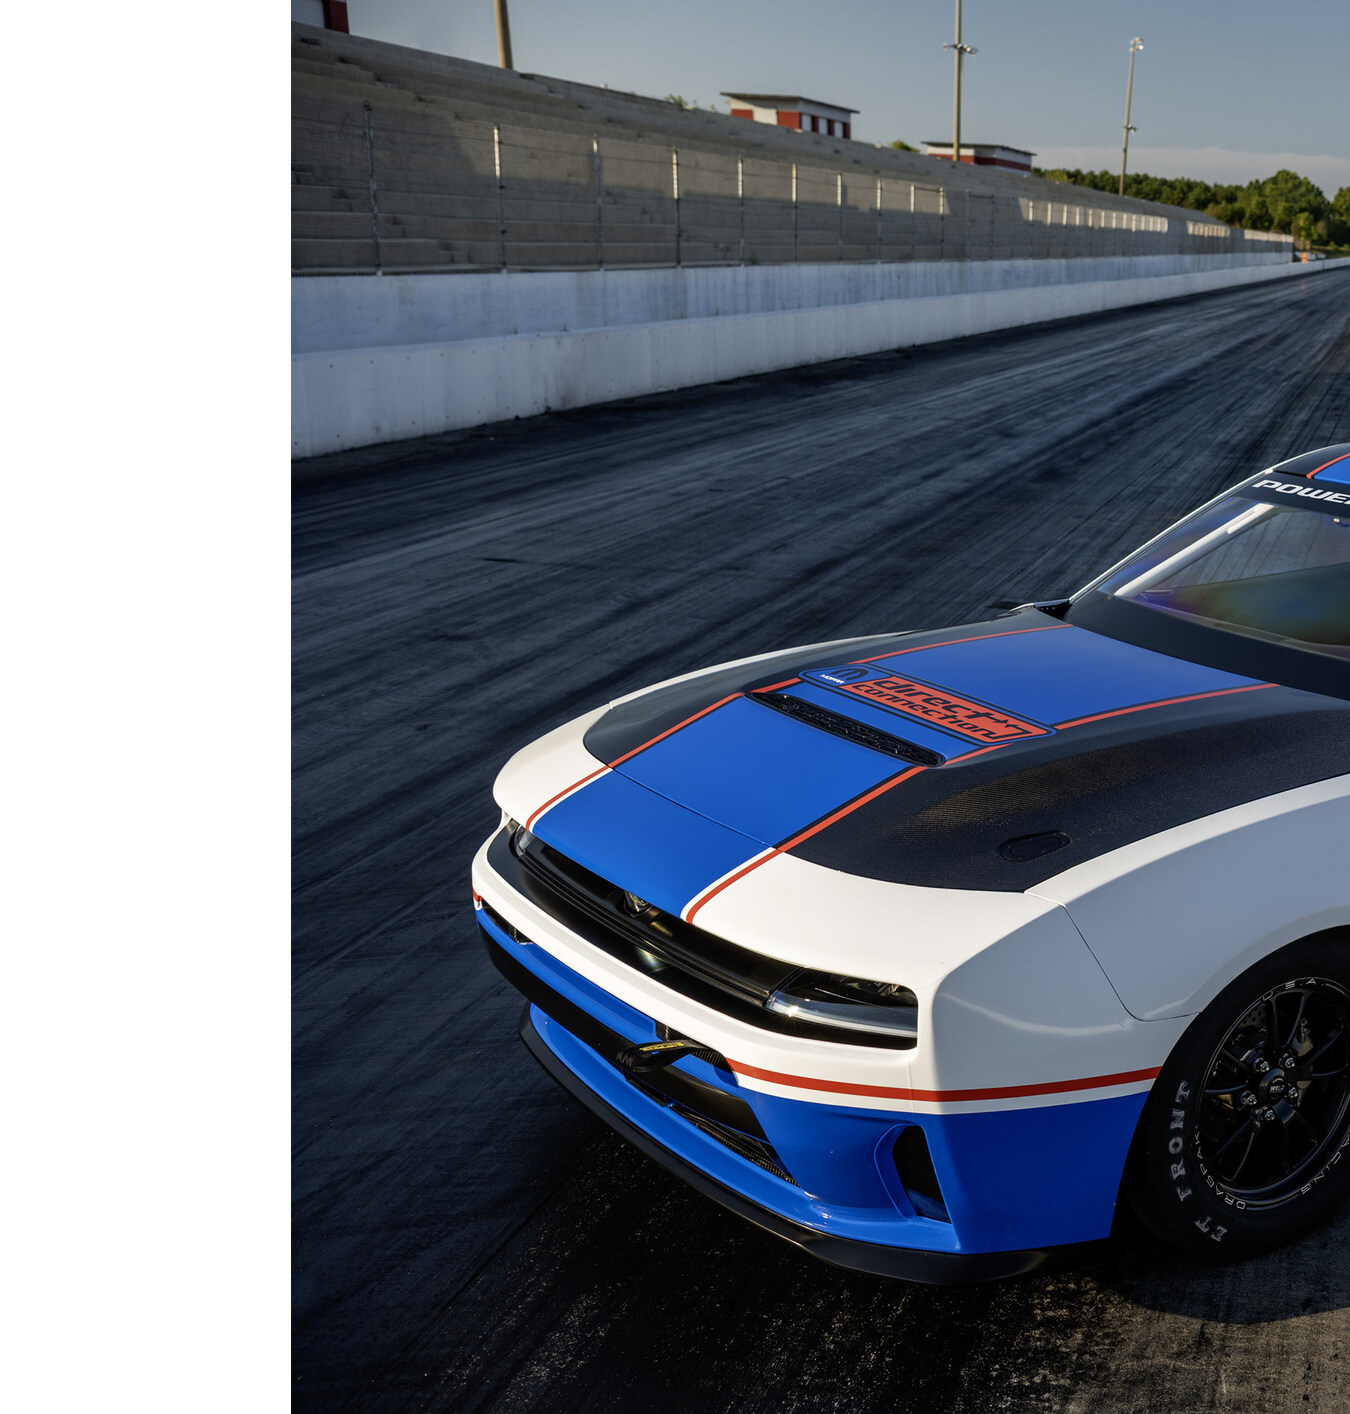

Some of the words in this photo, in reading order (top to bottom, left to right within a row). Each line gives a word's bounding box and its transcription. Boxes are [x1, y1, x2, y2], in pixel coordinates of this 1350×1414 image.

[851, 683, 999, 740] connection
[872, 679, 1000, 724] direct
[1168, 1080, 1192, 1202] FRONT
[1194, 1130, 1246, 1211] DRAGPAK
[1193, 1216, 1228, 1242] ET
